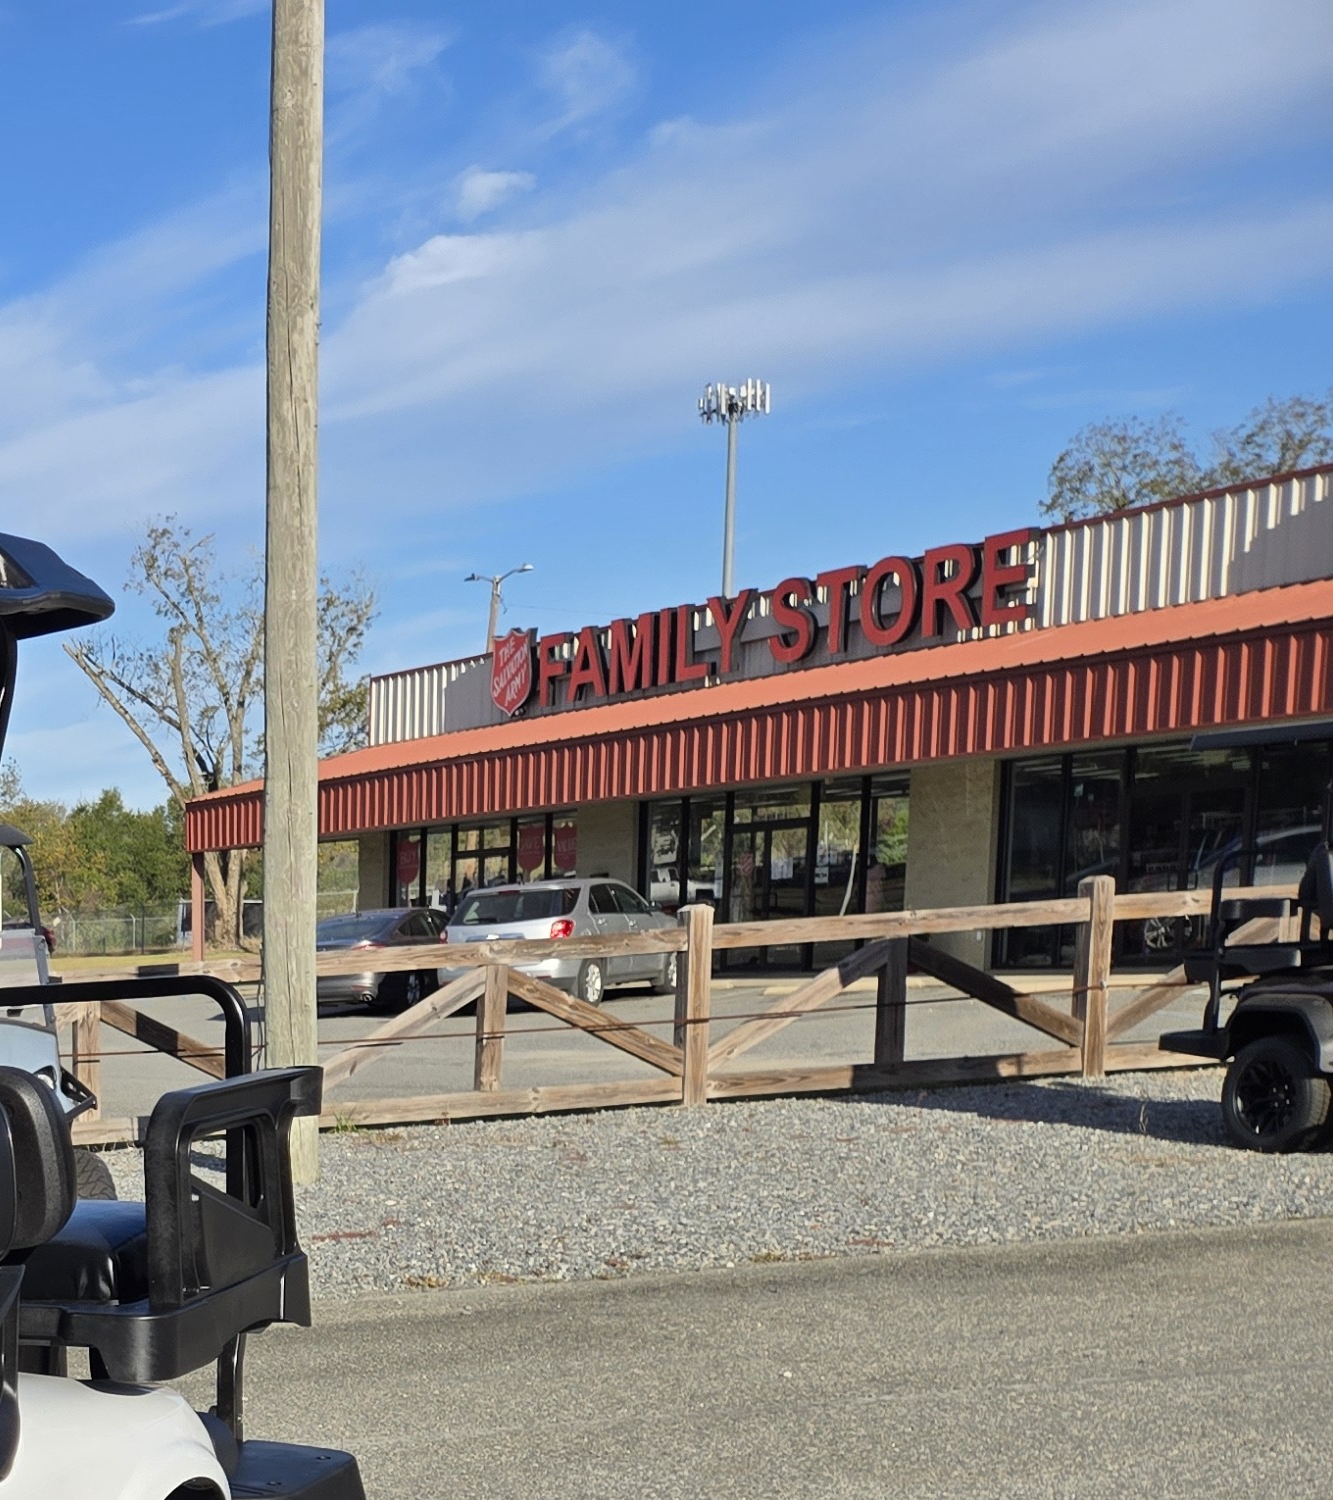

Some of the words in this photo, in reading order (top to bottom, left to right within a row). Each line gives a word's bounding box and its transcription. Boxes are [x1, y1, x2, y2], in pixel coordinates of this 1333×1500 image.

[538, 587, 758, 707] FAMILY
[767, 527, 1039, 664] STORE
[499, 636, 516, 667] THE
[504, 662, 527, 707] ARMY
